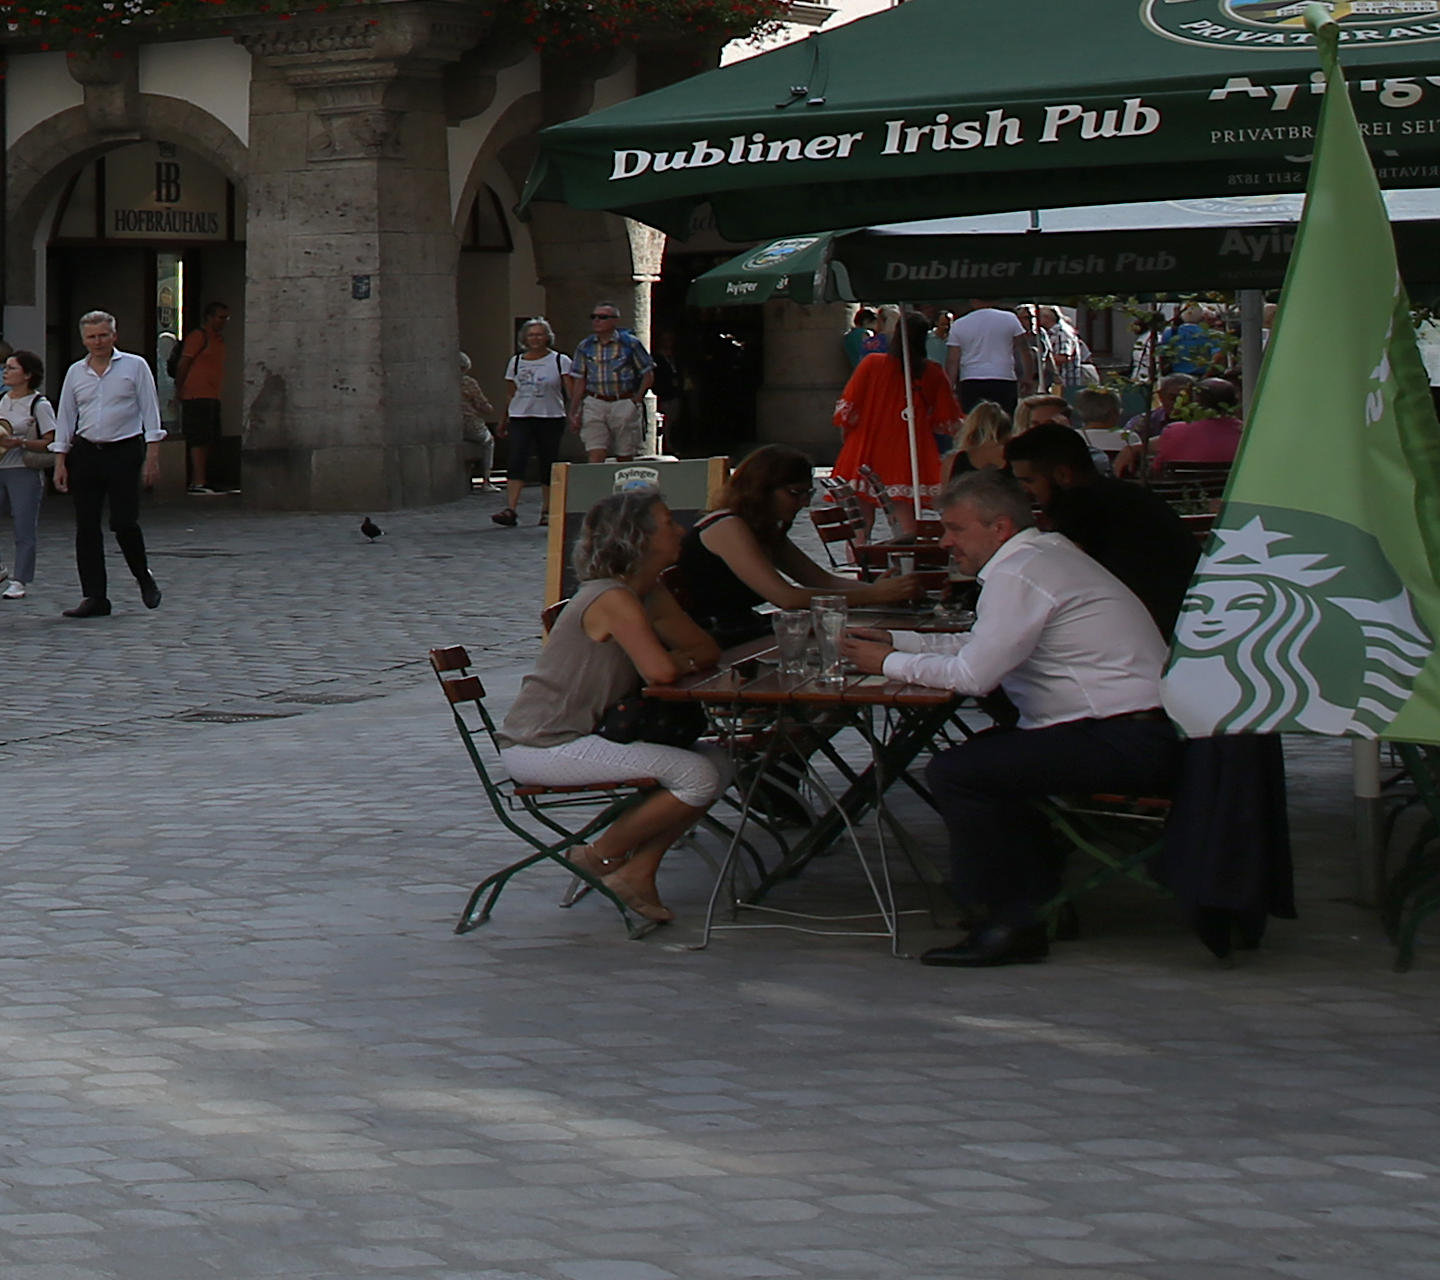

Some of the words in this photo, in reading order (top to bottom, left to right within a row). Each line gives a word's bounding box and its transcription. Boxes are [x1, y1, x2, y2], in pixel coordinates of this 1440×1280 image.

[608, 131, 863, 182] Dubliner
[880, 108, 1023, 155] Irish
[1039, 96, 1162, 143] Pub
[154, 161, 181, 204] HB
[114, 207, 218, 234] HOFBRÄUHAUS
[884, 257, 1021, 282] Dubliner
[1030, 254, 1105, 277] Irish
[1115, 251, 1177, 273] Pub
[616, 469, 657, 481] Ayinger
